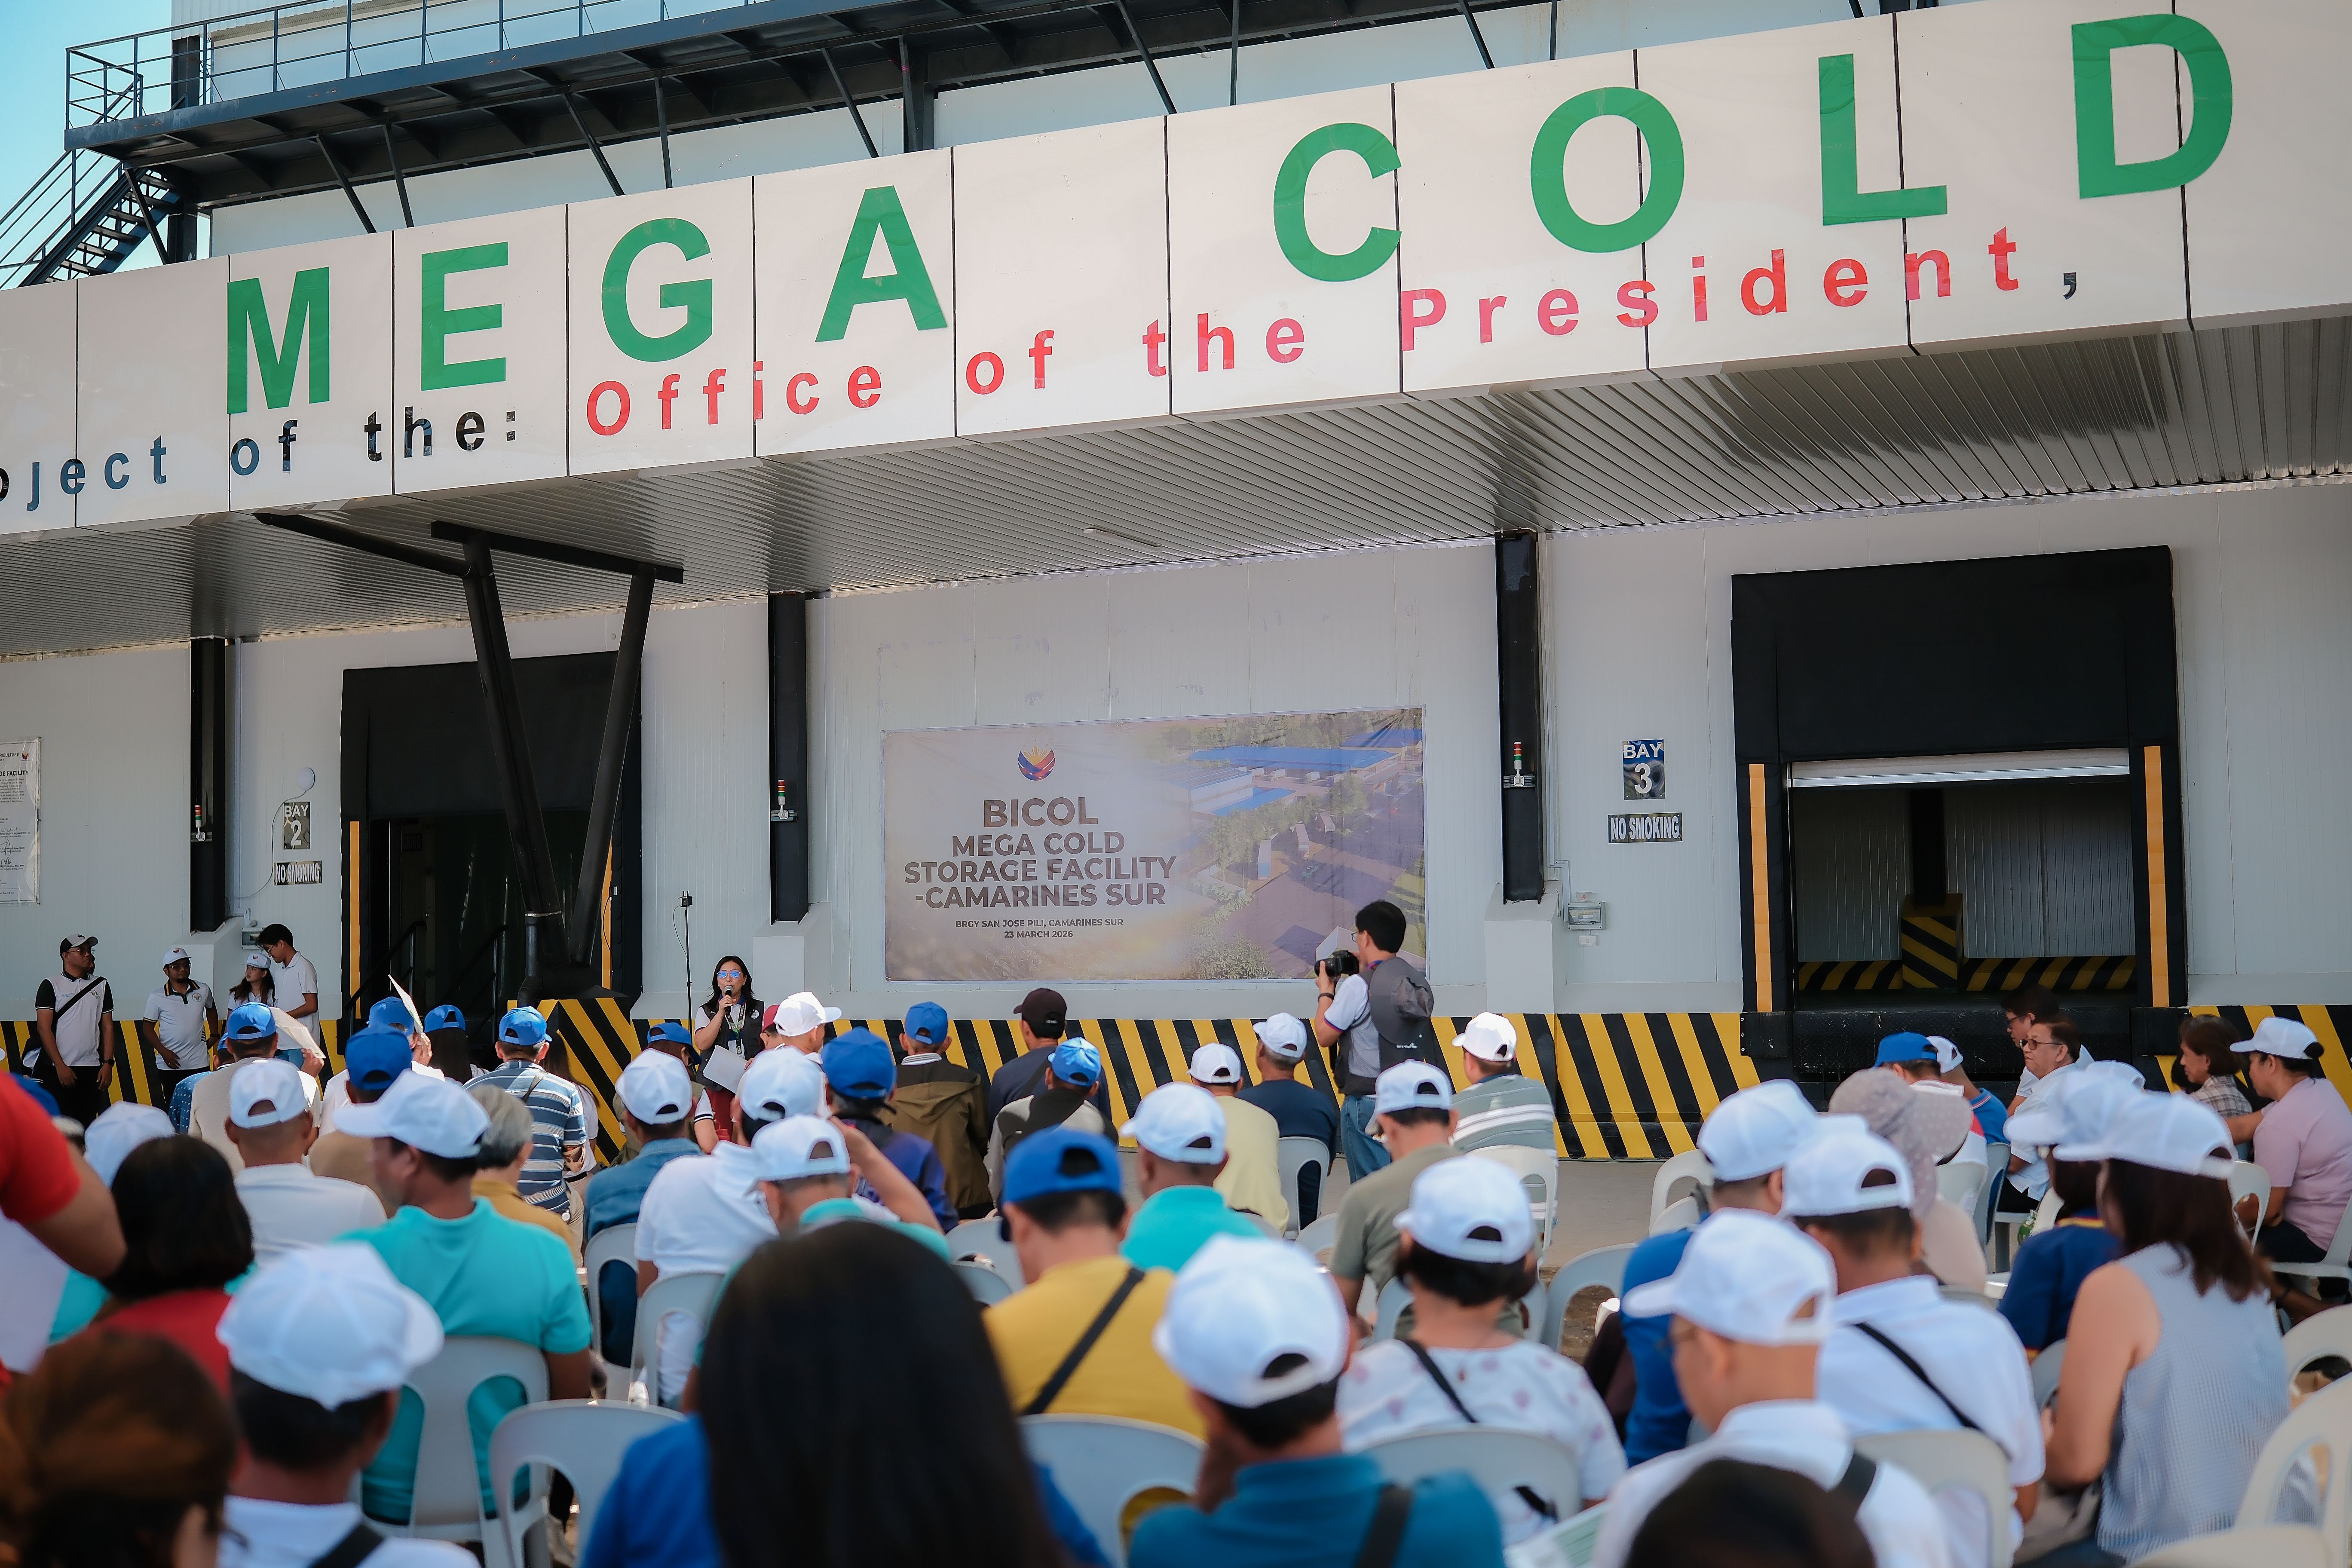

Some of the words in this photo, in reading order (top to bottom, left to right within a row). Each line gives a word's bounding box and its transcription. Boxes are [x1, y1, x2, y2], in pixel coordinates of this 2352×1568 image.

[227, 185, 948, 414] MEGA
[1273, 14, 2233, 282] COLD
[230, 419, 298, 476] of
[364, 405, 516, 462] the:
[586, 361, 882, 436] Office
[965, 329, 1055, 395] of
[1142, 313, 1305, 377] the
[1400, 226, 2077, 352] President,
[1624, 743, 1662, 758] BAY
[1634, 763, 1652, 794] 3
[284, 804, 309, 817] BAY
[983, 796, 1099, 828] BICOL
[290, 820, 302, 846] 2
[1611, 818, 1626, 840] NO
[1629, 816, 1679, 839] SMOKING
[952, 833, 1036, 857] MEGA
[1043, 831, 1125, 855] COLD
[276, 864, 285, 883] NO
[287, 862, 320, 882] SMOKING
[904, 859, 1038, 884] STORAGE
[1047, 856, 1177, 881] FACILITY
[915, 884, 1098, 909] -CAMARINES
[1106, 882, 1166, 906] SUR
[1027, 919, 1047, 928] PILI,
[1048, 919, 1103, 927] CAMARINES
